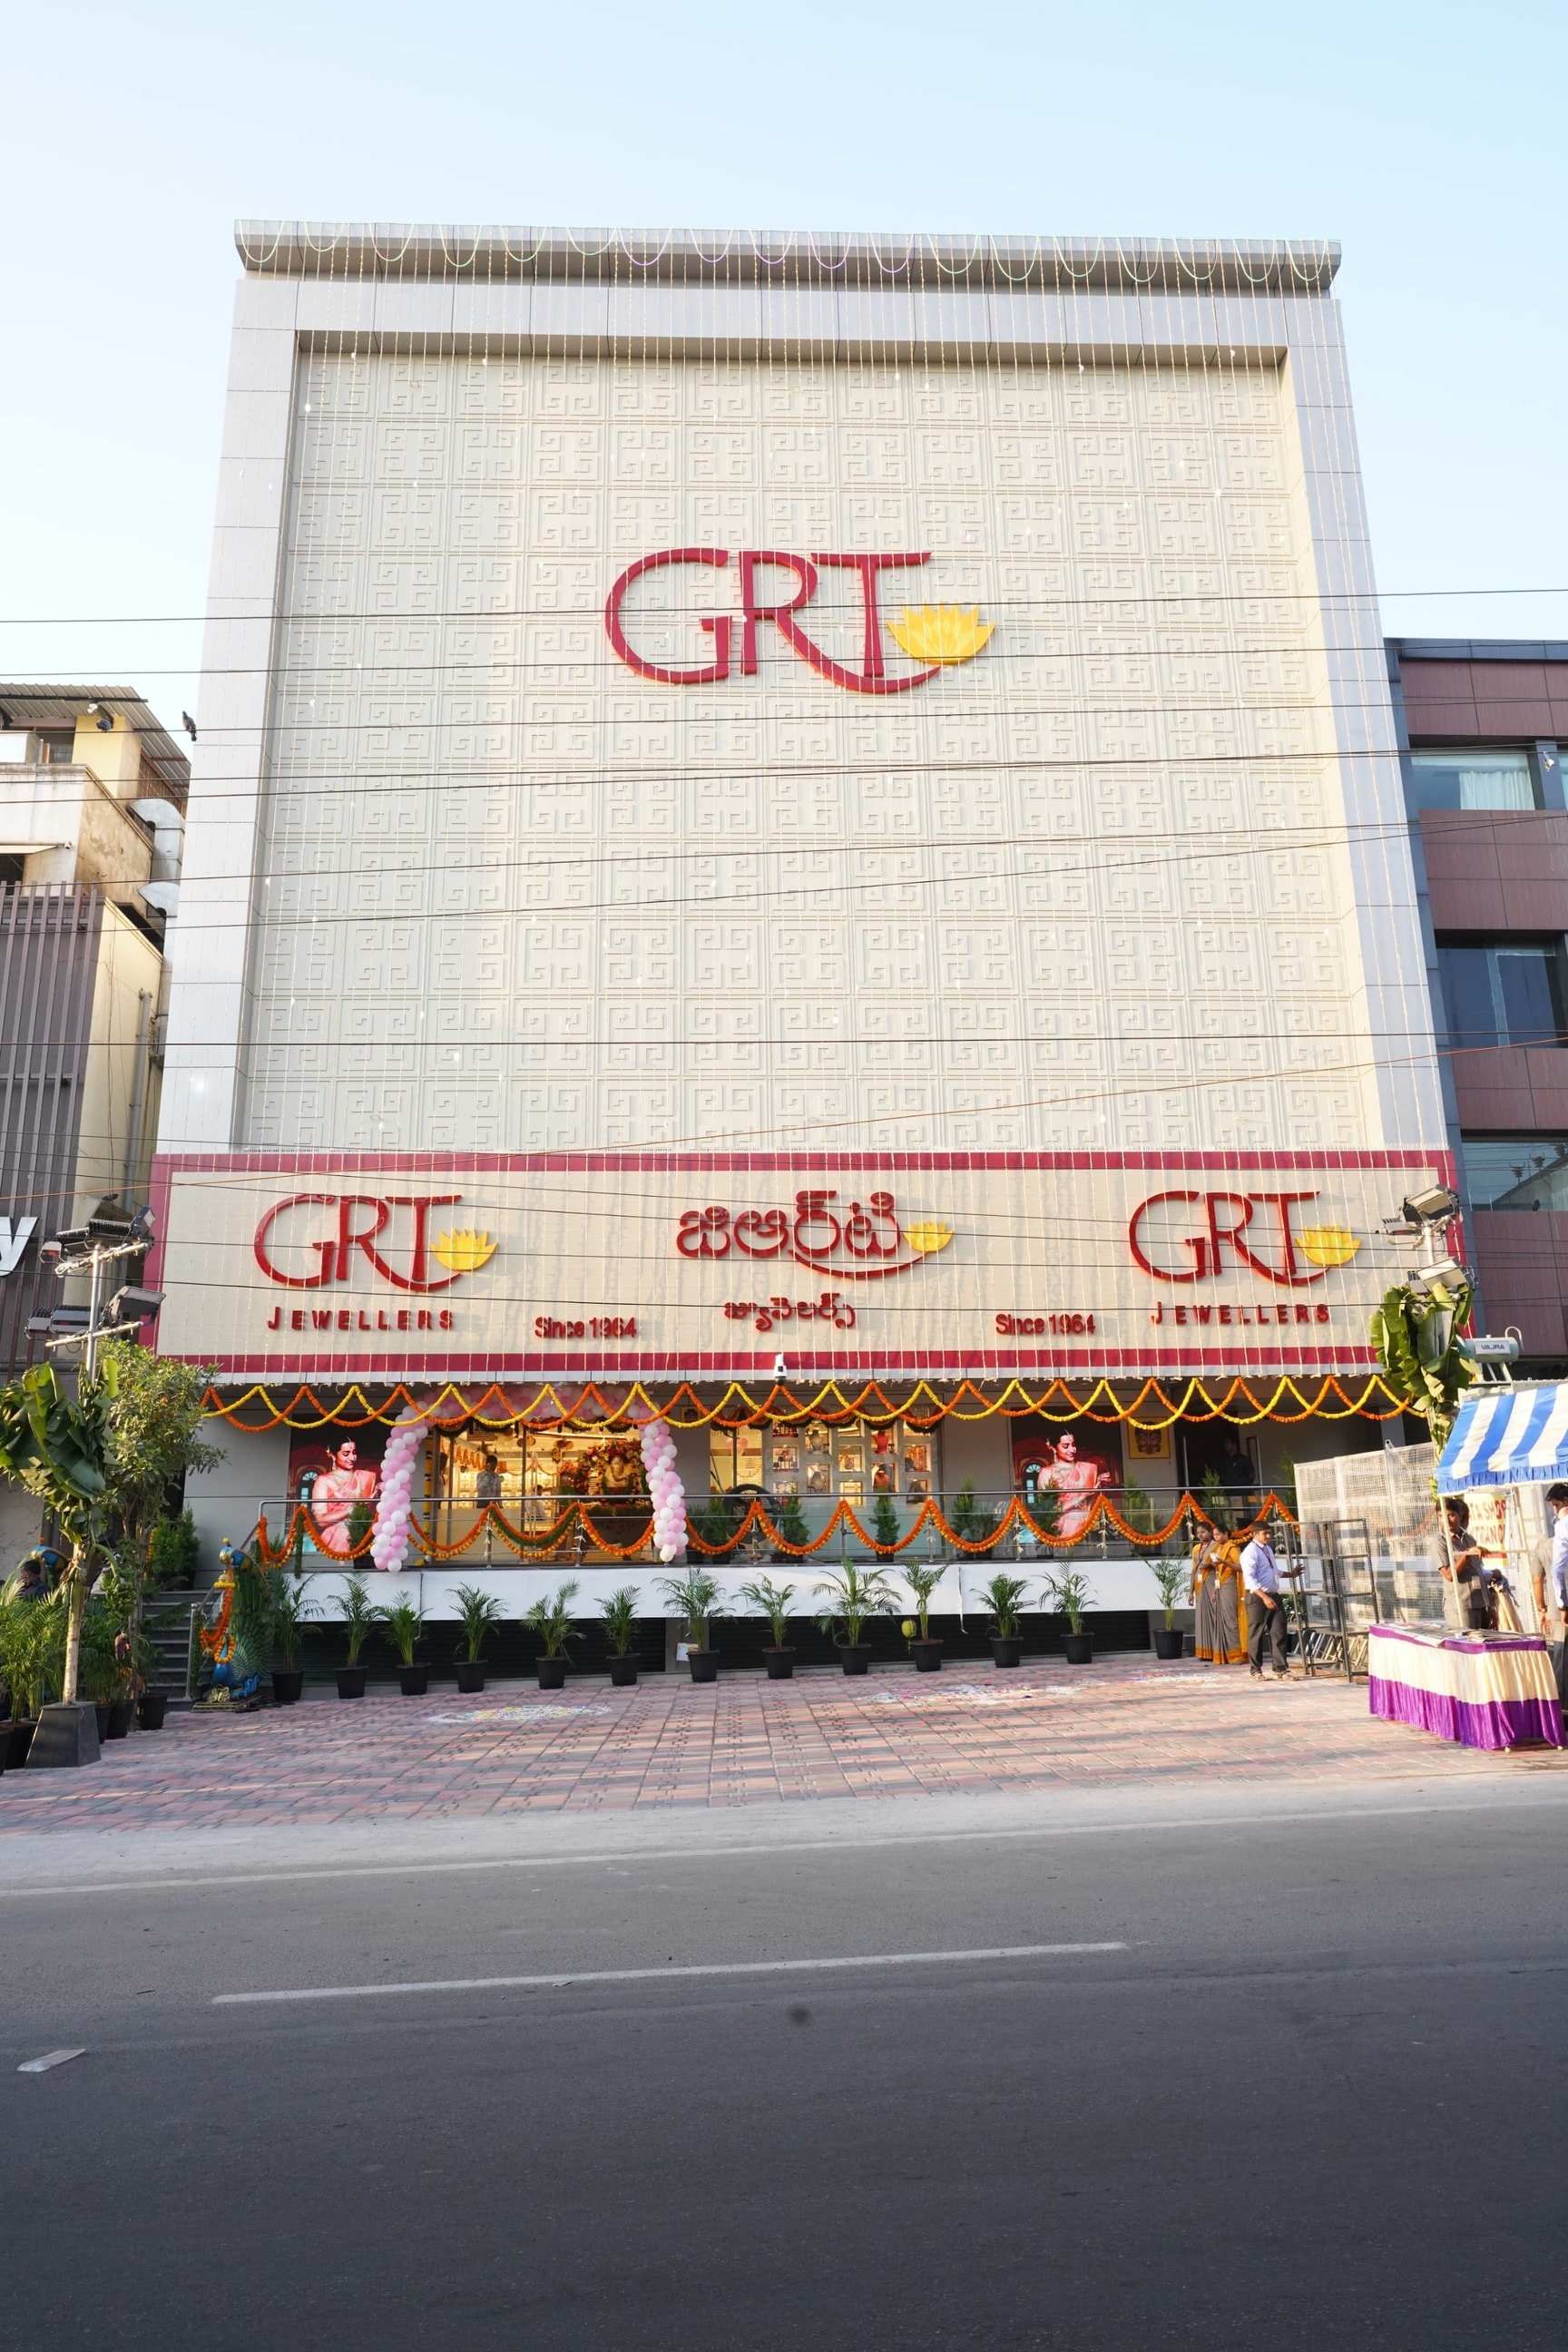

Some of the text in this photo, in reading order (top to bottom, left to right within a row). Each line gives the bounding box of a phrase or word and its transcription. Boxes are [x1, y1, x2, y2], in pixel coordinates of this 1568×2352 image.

[604, 547, 941, 693] GRT
[254, 1193, 462, 1292] GRT
[1129, 1191, 1331, 1286] GRT
[267, 1306, 453, 1330] JEWELLERS
[995, 1314, 1095, 1335] Since 1964
[1151, 1301, 1330, 1325] JEWELLERS
[534, 1317, 637, 1338] Since 1964
